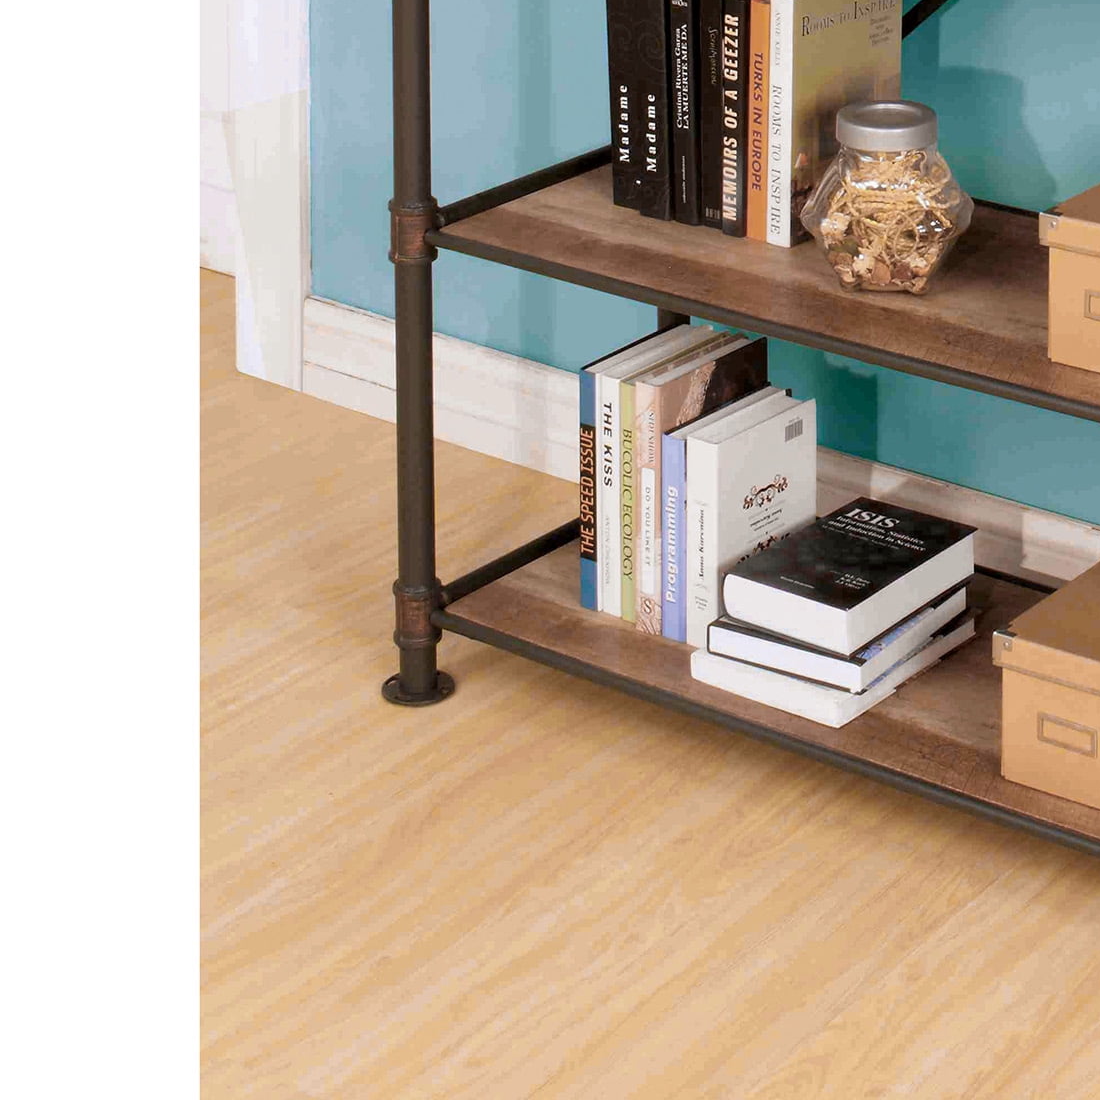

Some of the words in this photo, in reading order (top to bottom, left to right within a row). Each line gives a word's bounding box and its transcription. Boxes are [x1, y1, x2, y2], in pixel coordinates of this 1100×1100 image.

[681, 24, 688, 39] DA
[724, 14, 739, 82] GEEZER
[681, 62, 689, 112] MUERTE
[724, 90, 738, 101] A
[753, 52, 764, 103] TURKS
[617, 84, 631, 164] Madame
[646, 93, 657, 173] Madame
[675, 90, 683, 129] Cristina
[724, 106, 739, 129] OF
[752, 106, 763, 125] IN
[771, 85, 783, 136] ROOMS
[751, 129, 763, 191] EUROPE
[771, 144, 781, 162] TO
[723, 136, 738, 221] MEMOIRS
[770, 168, 782, 235] INSPIRE
[603, 402, 613, 438] THE
[580, 427, 594, 475] ISSUE
[603, 444, 613, 488] KISS
[622, 428, 633, 501] BUCOLIC
[580, 476, 594, 523] SPEED
[645, 487, 651, 502] DO
[845, 508, 900, 529] ISIS
[580, 524, 595, 554] THE
[622, 503, 633, 581] ECOLOGY
[665, 485, 679, 605] Programming
